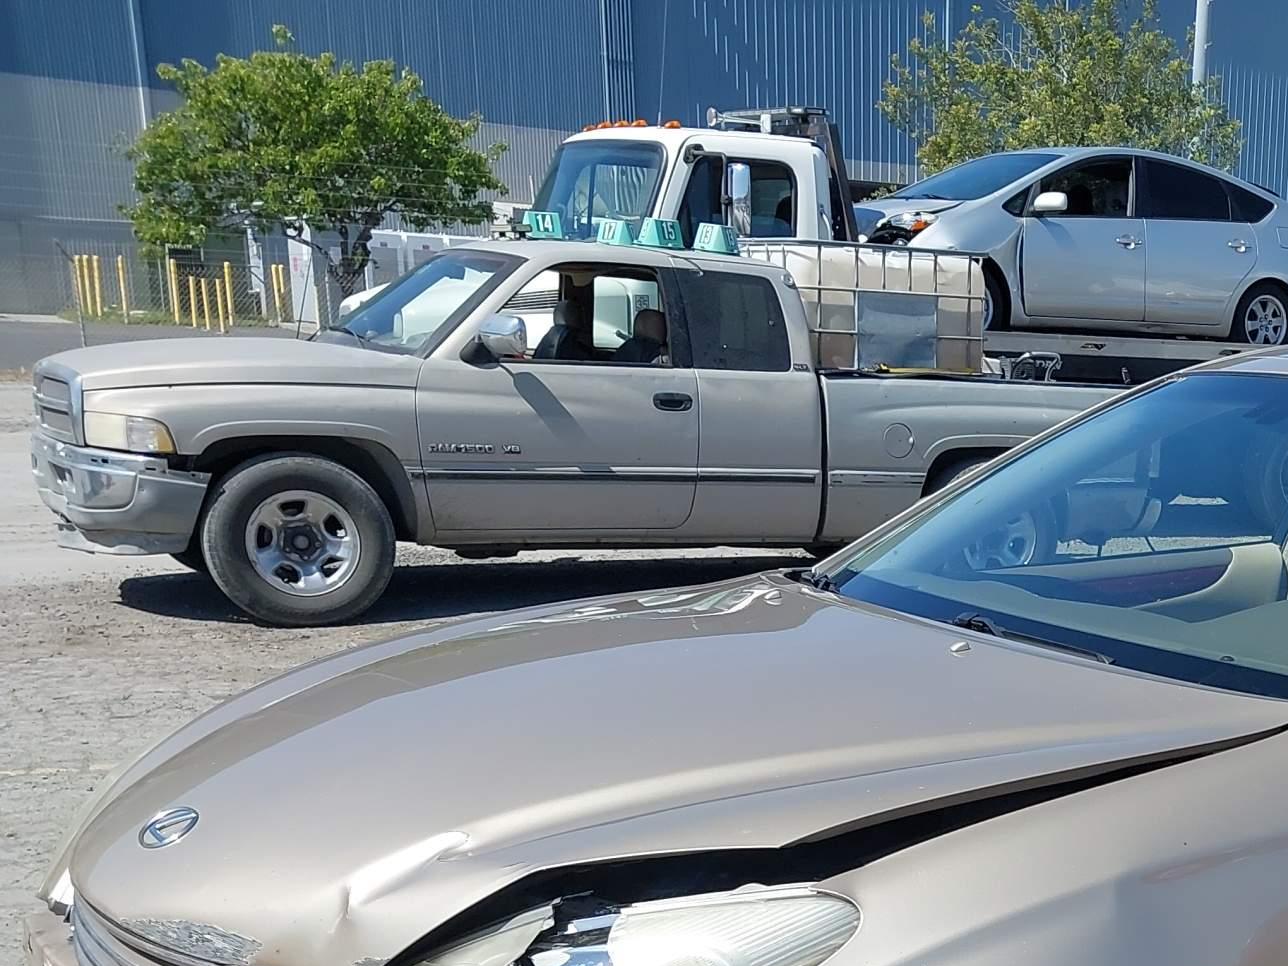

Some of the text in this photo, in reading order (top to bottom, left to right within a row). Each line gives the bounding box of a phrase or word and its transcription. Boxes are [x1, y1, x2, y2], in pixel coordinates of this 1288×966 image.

[536, 214, 554, 232] 14
[602, 222, 617, 240] 17
[662, 222, 676, 240] 15
[699, 224, 713, 244] 13
